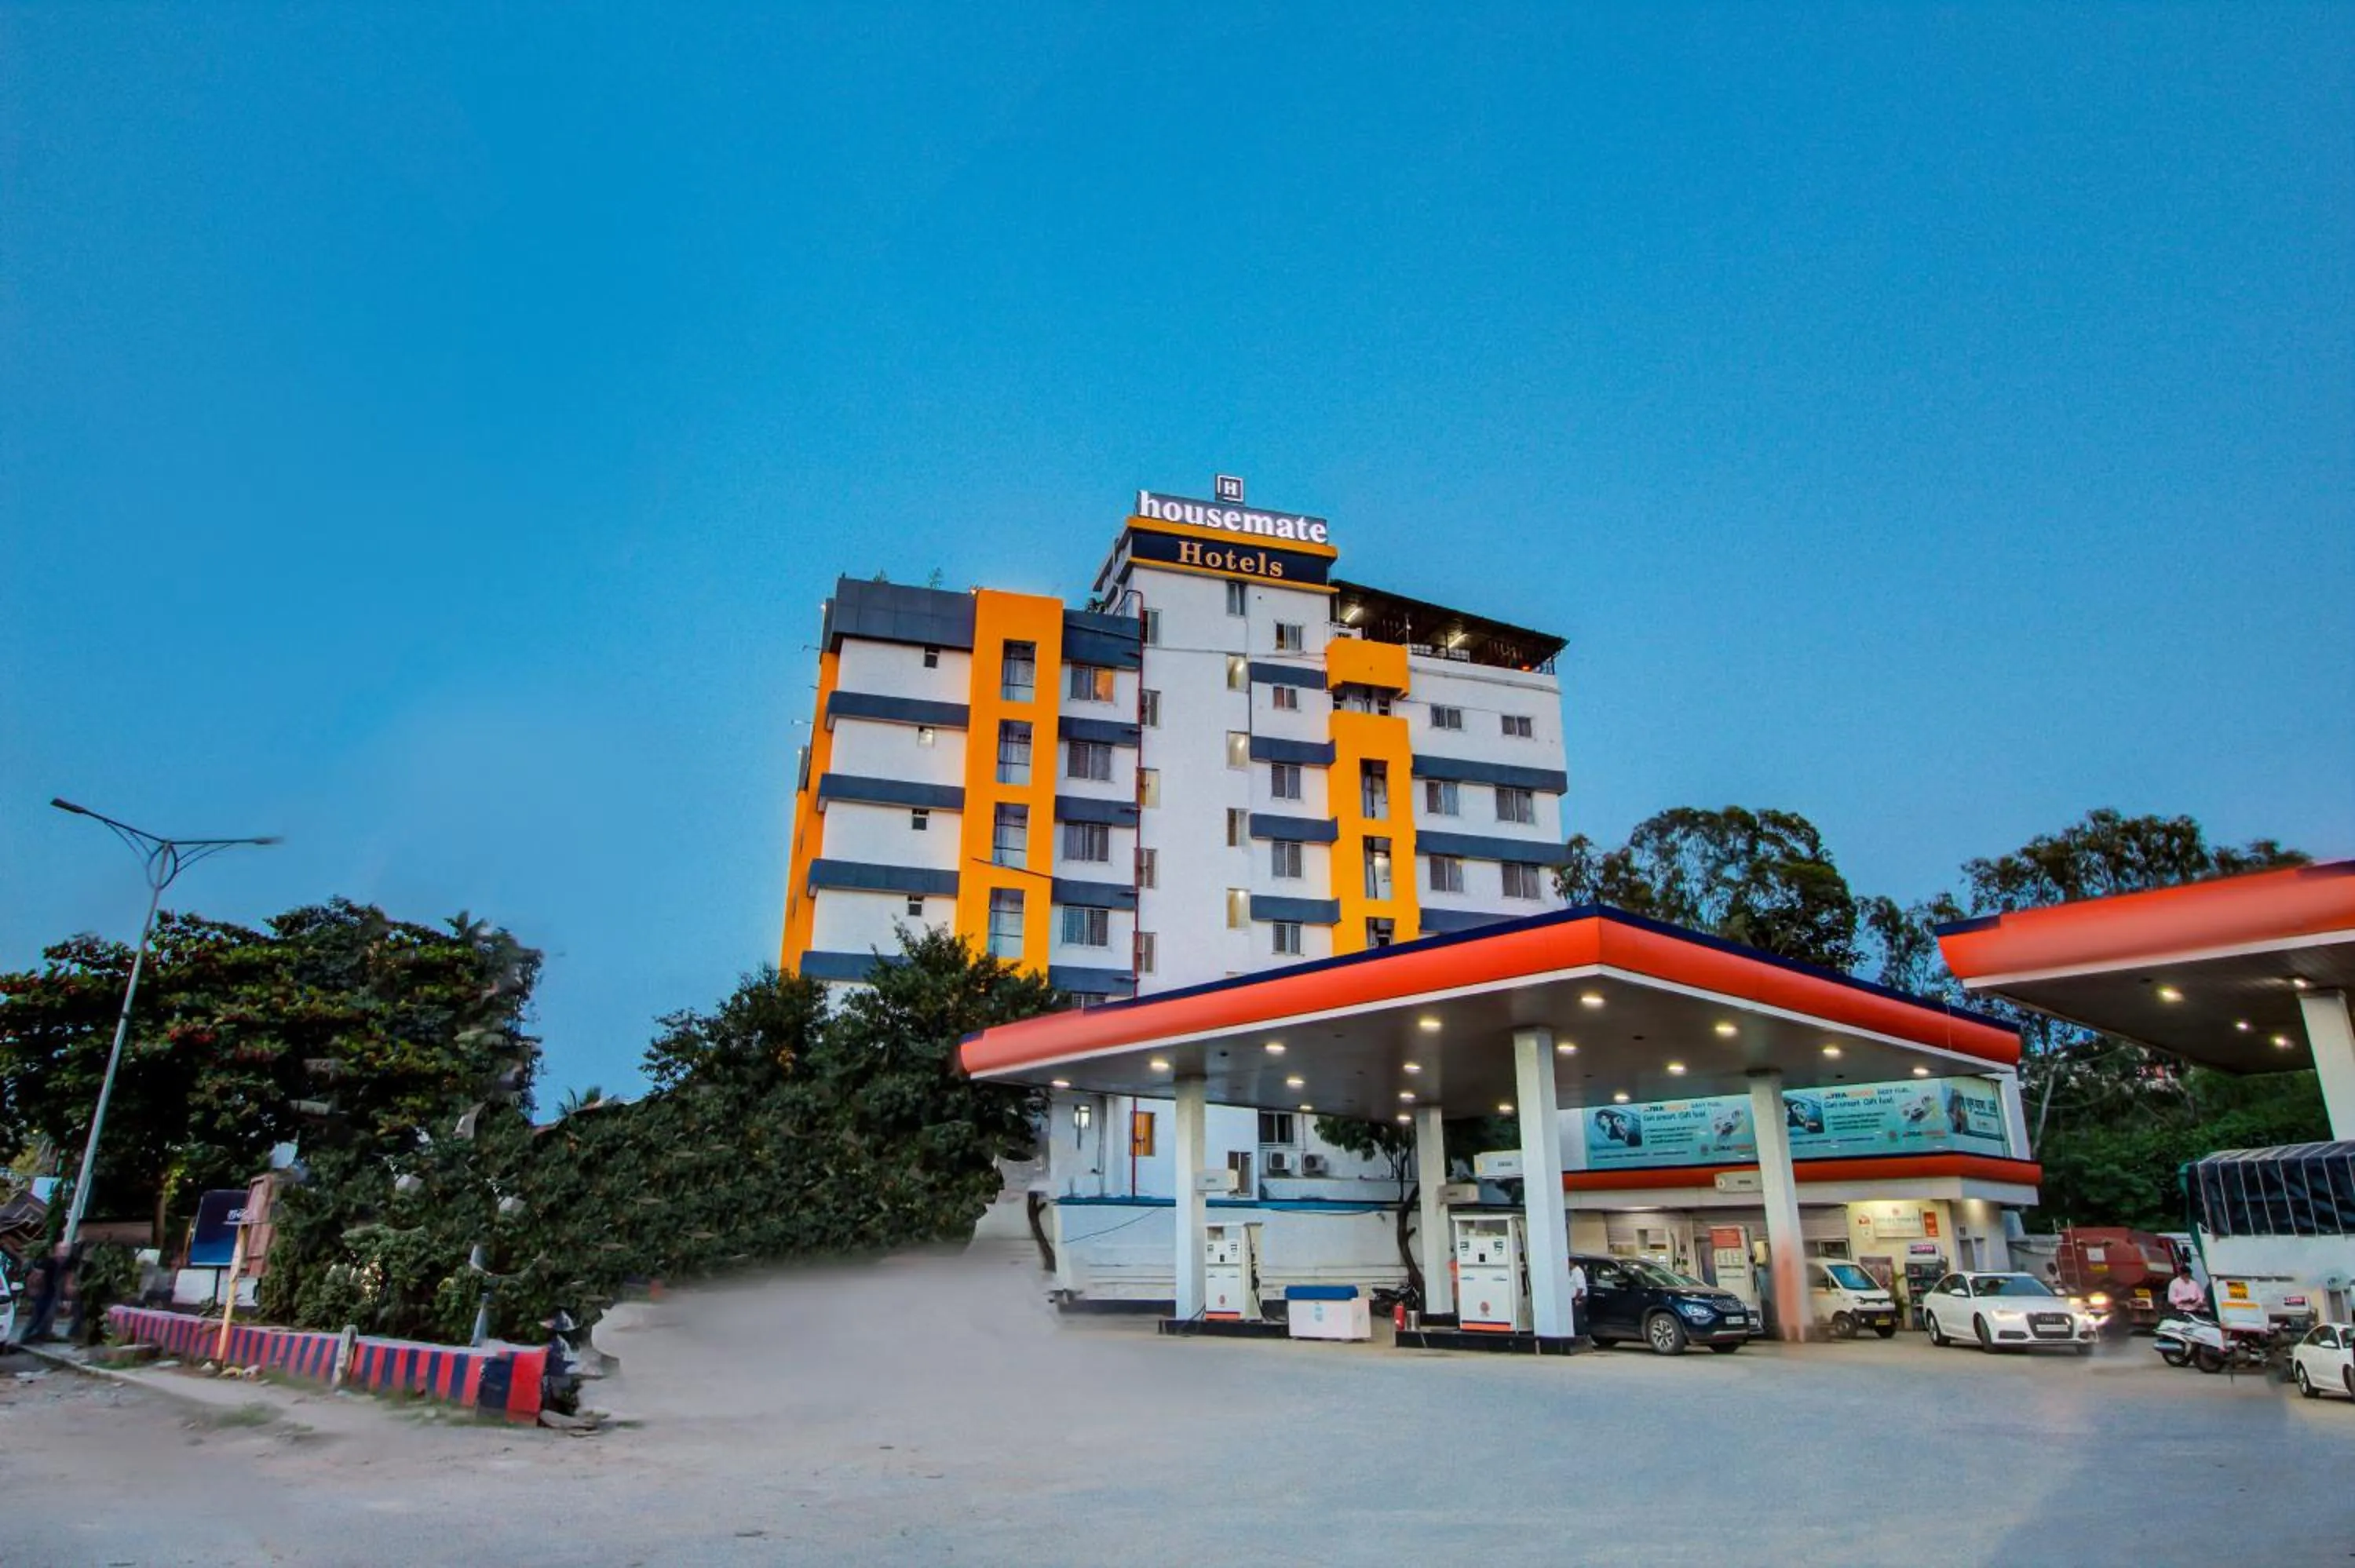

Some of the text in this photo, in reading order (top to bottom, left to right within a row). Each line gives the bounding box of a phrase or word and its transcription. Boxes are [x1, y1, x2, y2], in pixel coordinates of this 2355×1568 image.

[1225, 482, 1238, 497] H
[1138, 490, 1327, 544] housemate
[1178, 541, 1283, 578] Hotels
